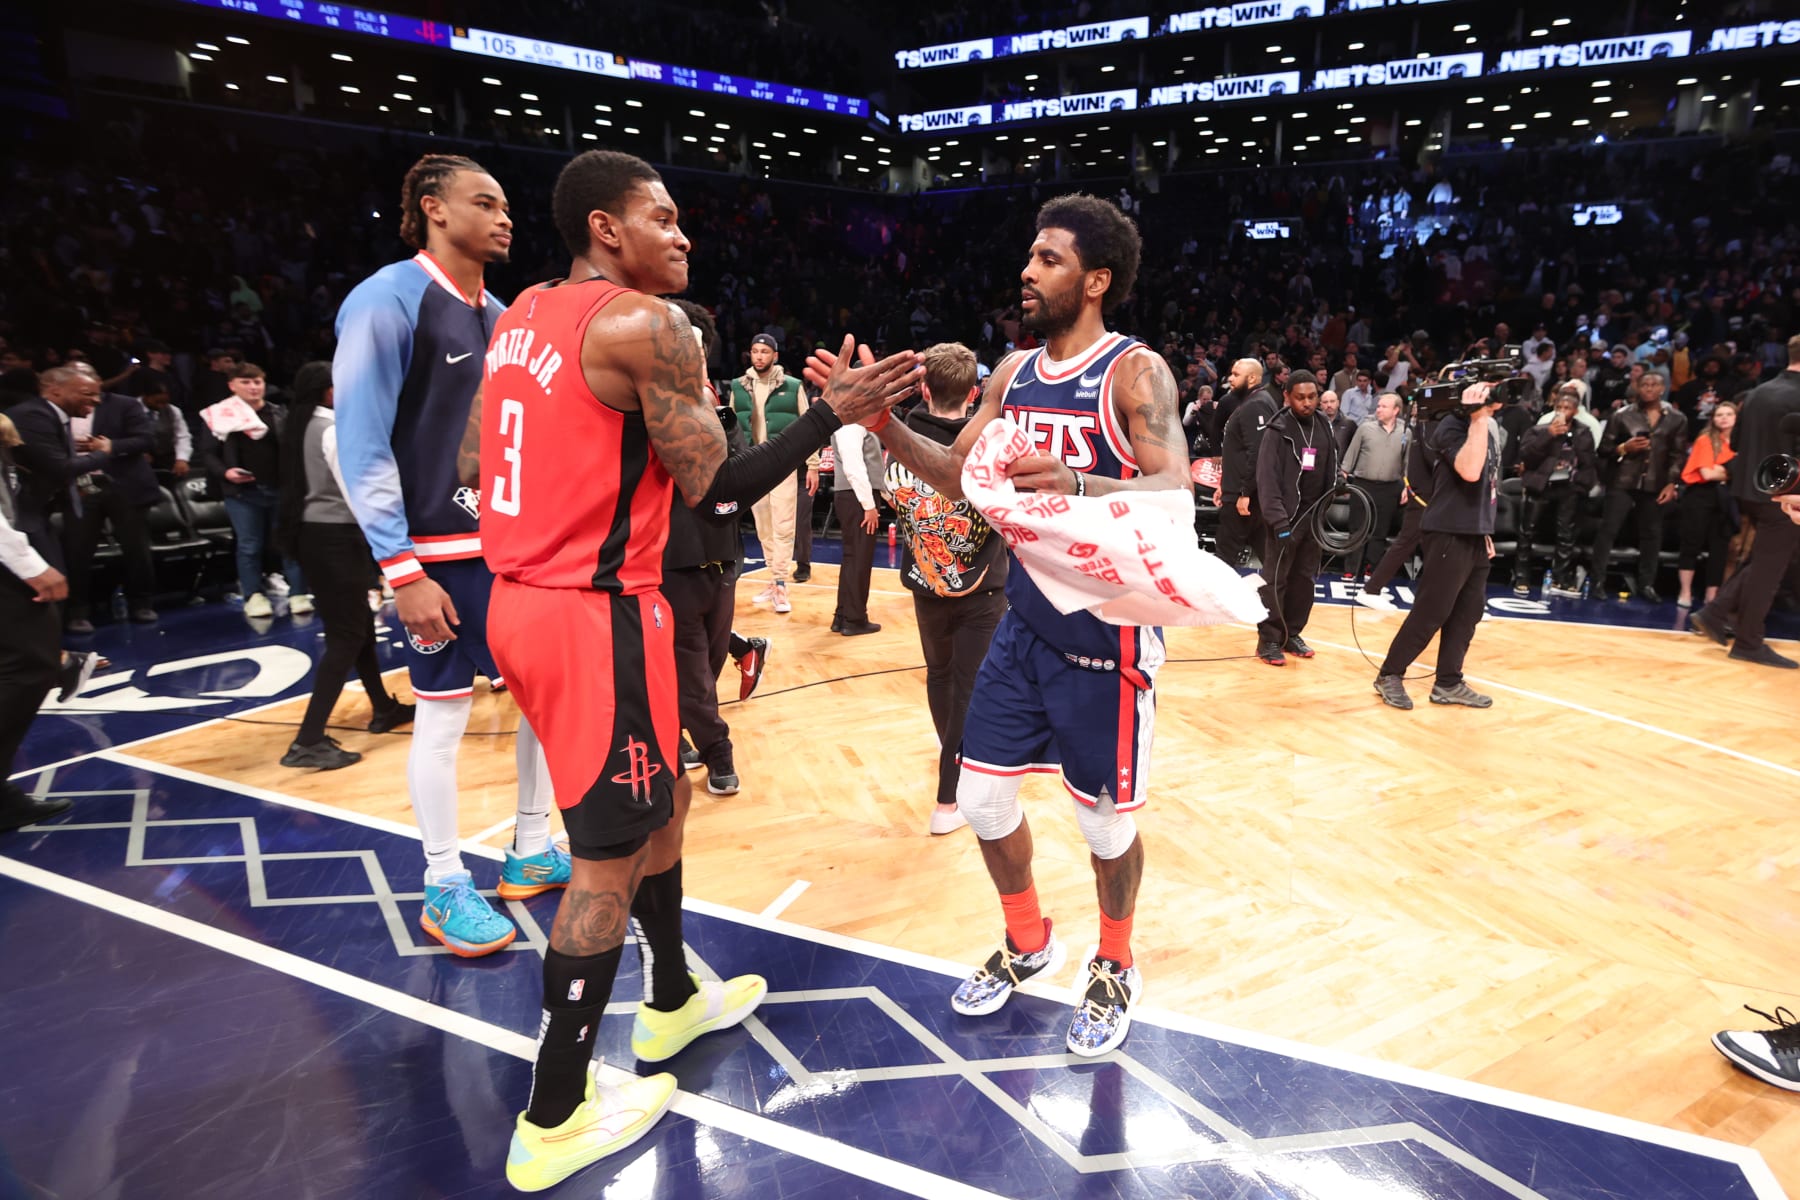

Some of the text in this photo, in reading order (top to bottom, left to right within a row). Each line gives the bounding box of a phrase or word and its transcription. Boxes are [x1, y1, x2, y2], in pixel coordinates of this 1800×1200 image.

[480, 35, 516, 56] 105
[533, 43, 553, 56] 0.0
[574, 51, 605, 70] 118
[922, 47, 959, 63] WIN!
[1011, 29, 1067, 54] NETS
[1069, 26, 1110, 43] WIN!
[1169, 7, 1232, 34] NETS
[1235, 3, 1281, 22] WIN!
[629, 60, 662, 79] NETS
[926, 111, 963, 128] WIN!
[1004, 99, 1061, 121] NETS
[1063, 95, 1105, 113] WIN!
[1151, 82, 1214, 105] NETS
[1217, 79, 1264, 97] WIN!
[1315, 64, 1386, 90] NETS
[1389, 61, 1442, 79] WIN!
[1499, 43, 1581, 72] NETS
[1584, 40, 1645, 61] WIN!
[1710, 20, 1800, 51] NETS
[528, 343, 563, 395] JR.
[1075, 390, 1097, 399] Webull
[491, 398, 524, 517] 3
[1003, 405, 1100, 473] NETS
[1073, 557, 1112, 572] STEEL
